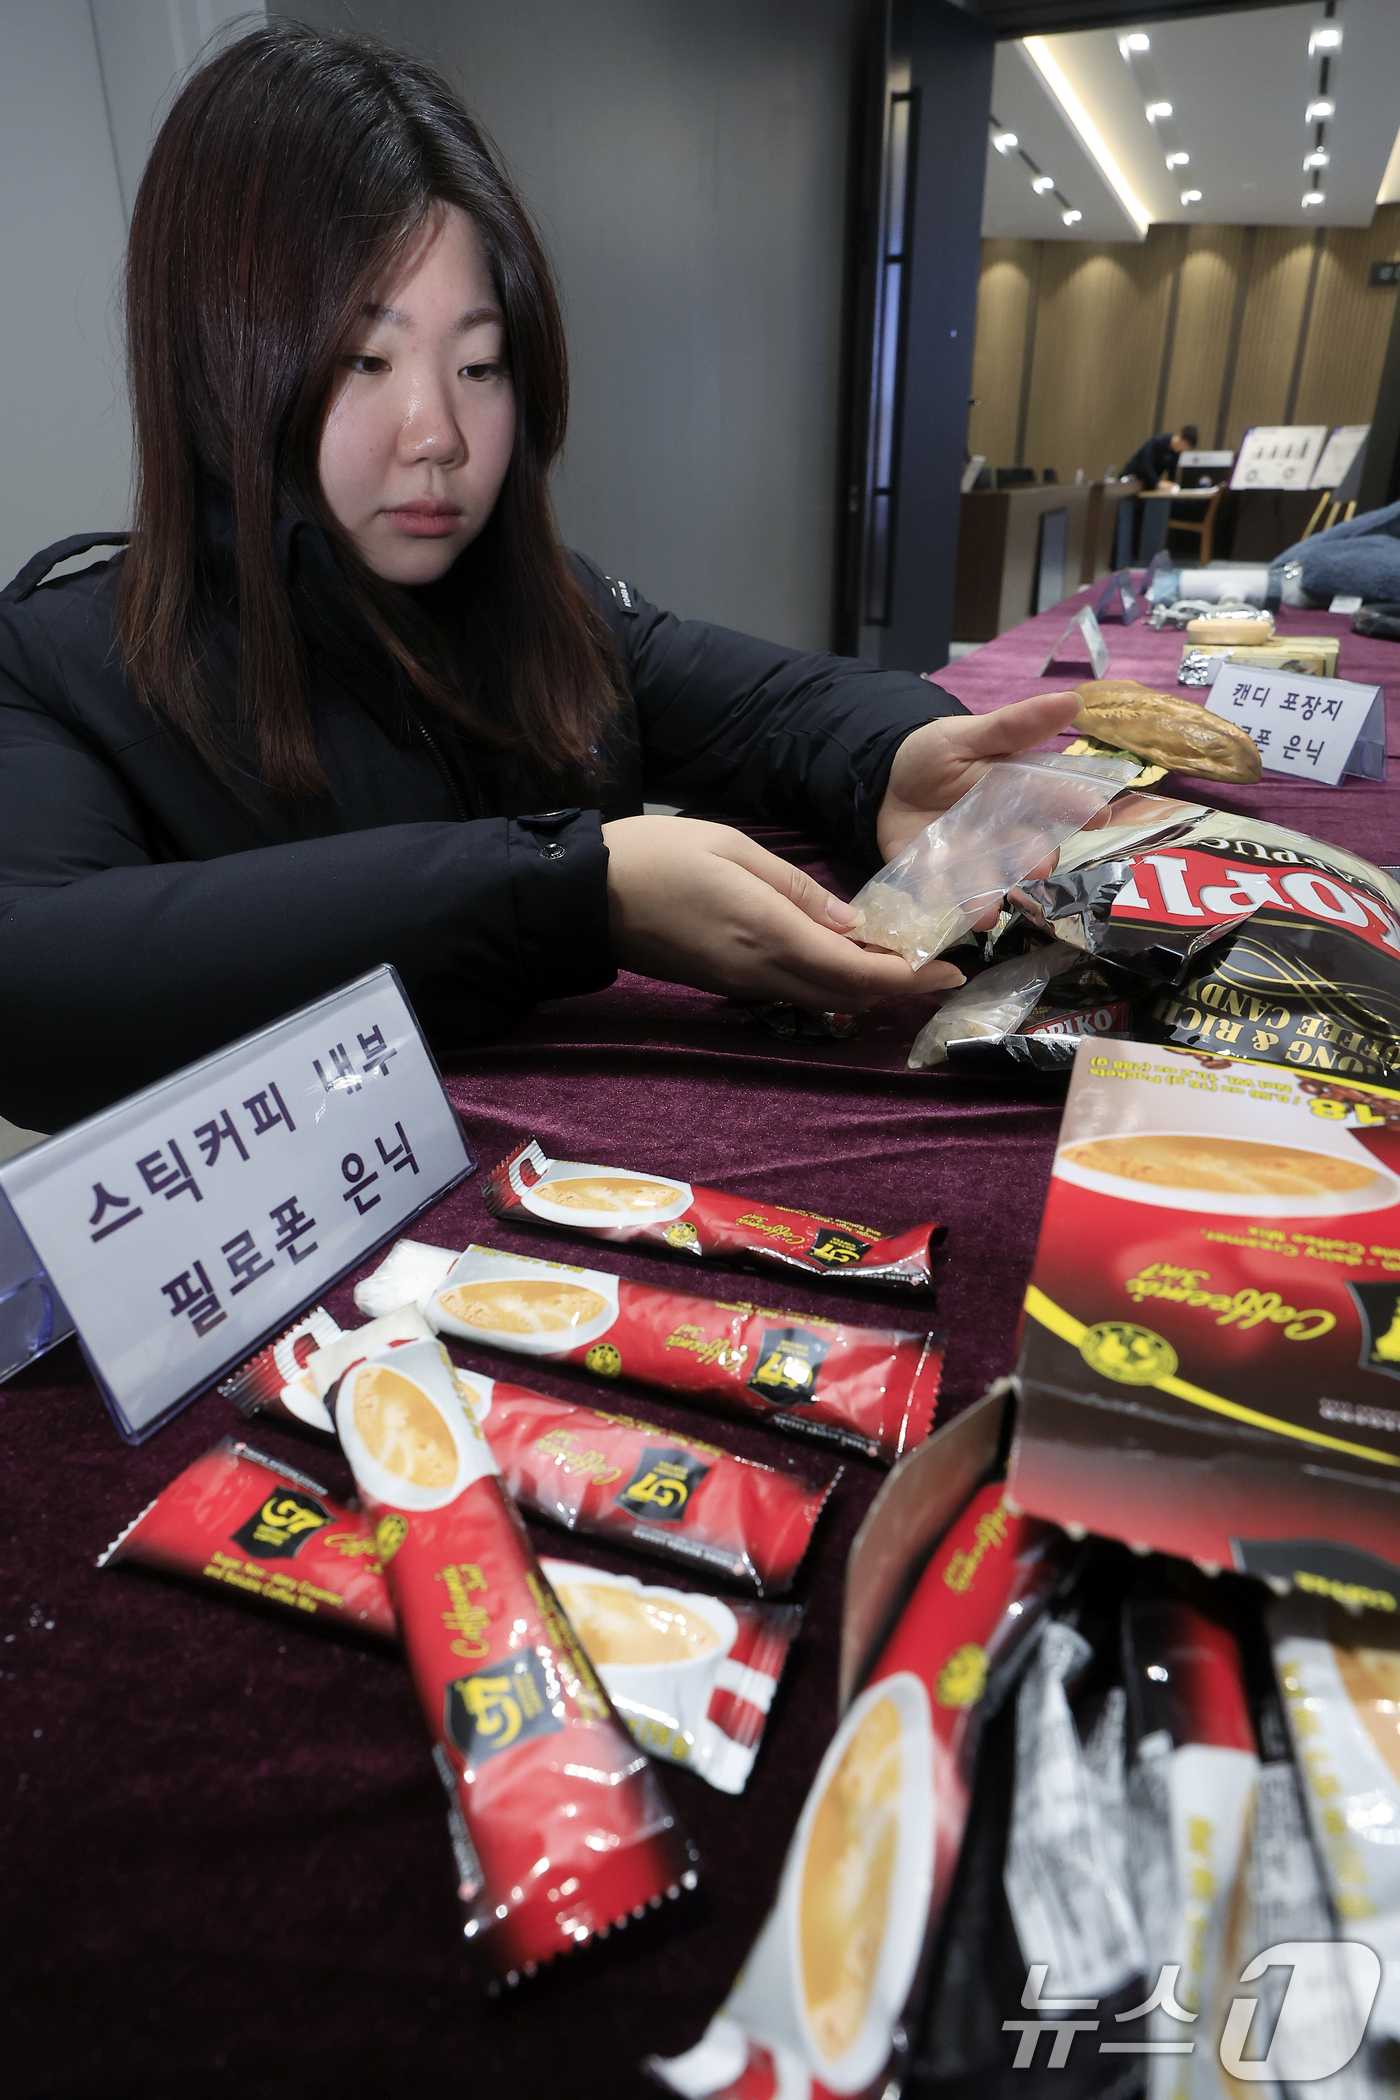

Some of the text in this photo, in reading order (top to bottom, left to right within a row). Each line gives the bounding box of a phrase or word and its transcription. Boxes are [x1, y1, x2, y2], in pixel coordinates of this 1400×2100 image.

[1232, 683, 1343, 722] 캔디 포장지
[1283, 735, 1325, 766] 은닉
[1181, 977, 1291, 1030] CANDY
[1152, 1001, 1377, 1075] ONG & RICH
[1089, 1067, 1162, 1085] Packets
[1308, 1098, 1386, 1126] 18
[89, 1024, 397, 1243] 스틱커피 내부
[161, 1122, 420, 1337] 필로폰 은닉
[621, 1471, 688, 1508] G7
[261, 1497, 331, 1534] G7
